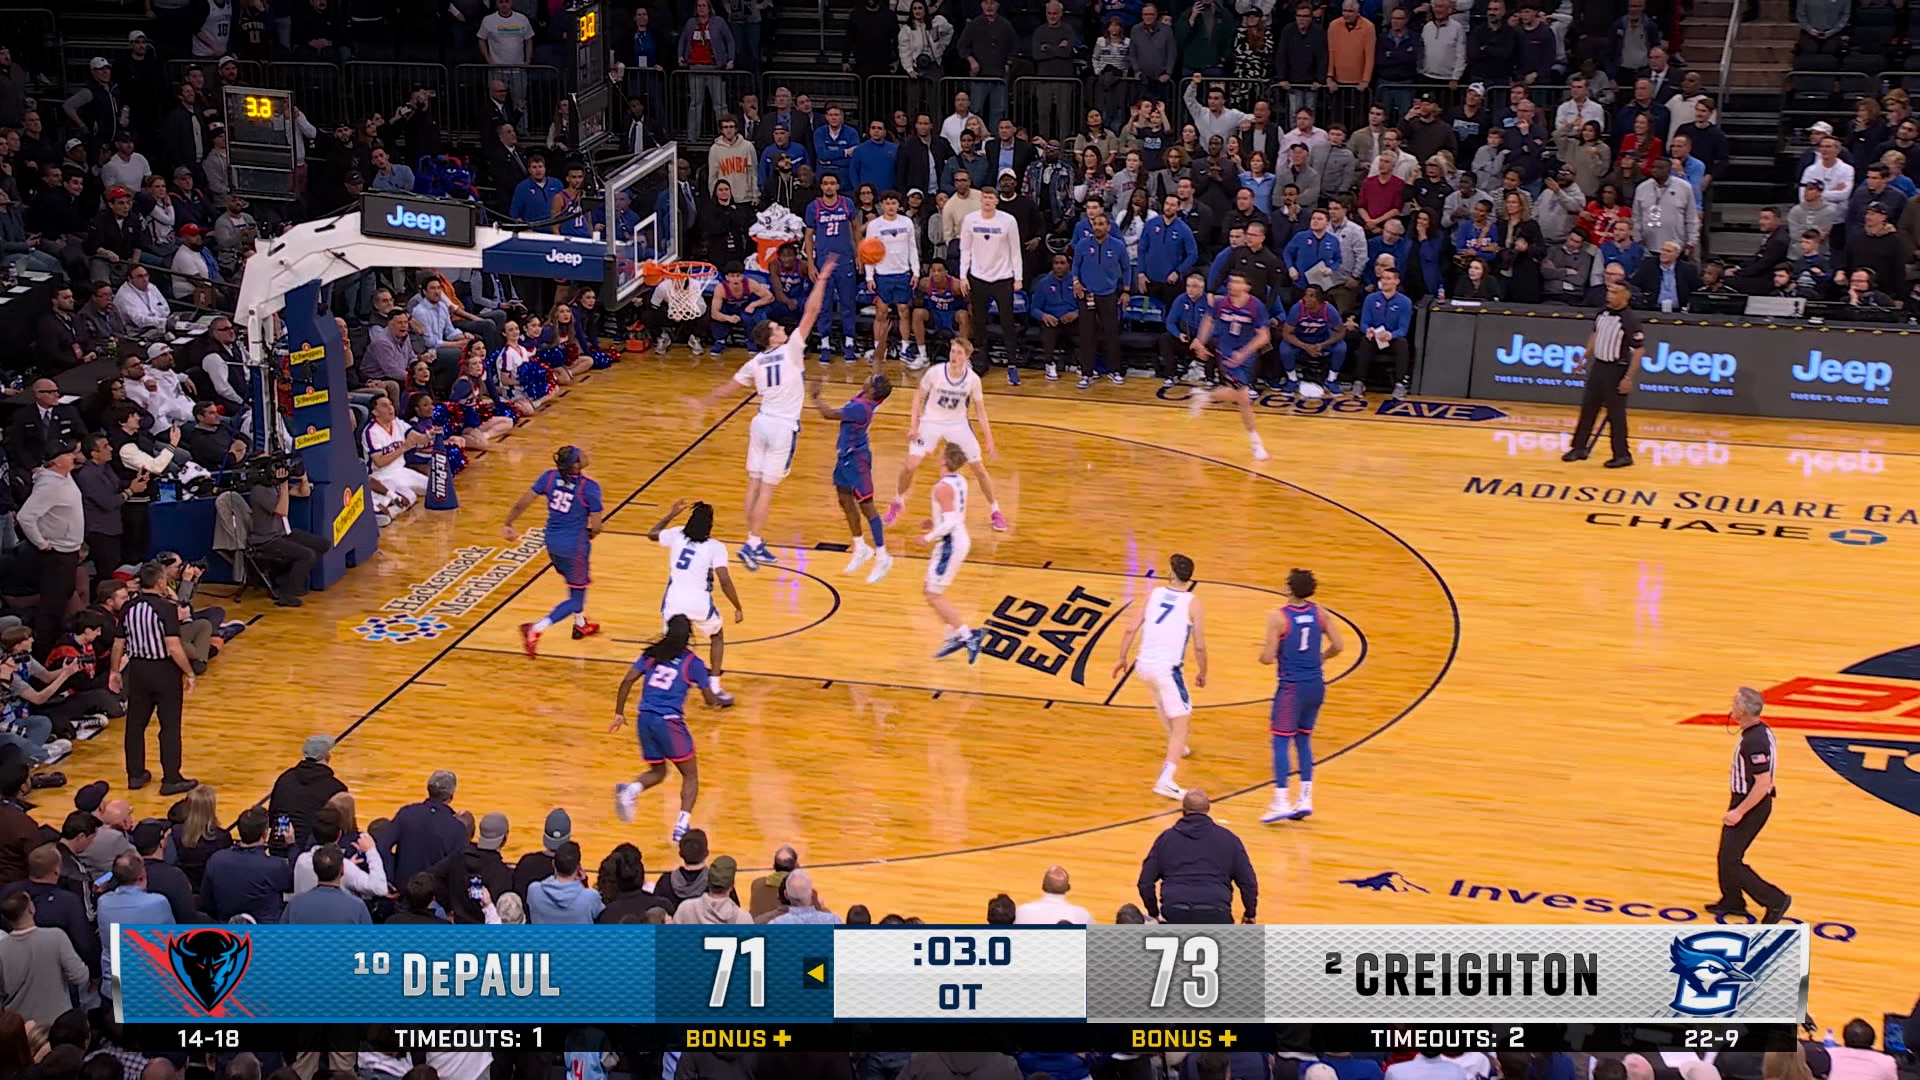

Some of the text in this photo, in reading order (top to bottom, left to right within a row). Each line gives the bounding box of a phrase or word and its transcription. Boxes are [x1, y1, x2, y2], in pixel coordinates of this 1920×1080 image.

[387, 205, 446, 235] Jeep
[826, 222, 839, 236] 21
[546, 249, 582, 266] Jeep
[1496, 334, 1586, 374] Jeep
[1641, 342, 1737, 382] Jeep
[766, 364, 780, 388] 11
[1495, 375, 1585, 388] THERE'S ONLY ONE
[1792, 350, 1893, 391] Jeep
[1156, 384, 1368, 414] Cege
[1392, 401, 1475, 420] AVE
[1640, 383, 1734, 396] THERE'S ONLY ONE
[1790, 392, 1889, 405] THERE'S ONLY ONE
[550, 489, 575, 514] 35
[1463, 477, 1920, 525] MADISON SQUARE GA
[1585, 512, 1813, 540] CHASE
[676, 548, 696, 571] 5
[384, 546, 493, 612] Hackensack
[430, 564, 516, 615] Meridian
[1155, 602, 1174, 625] 7
[980, 595, 1049, 661] BIG
[1016, 585, 1112, 676] EAST
[1297, 626, 1311, 652] 1
[648, 664, 679, 691] 23
[1448, 879, 1857, 942] Invesco QQ
